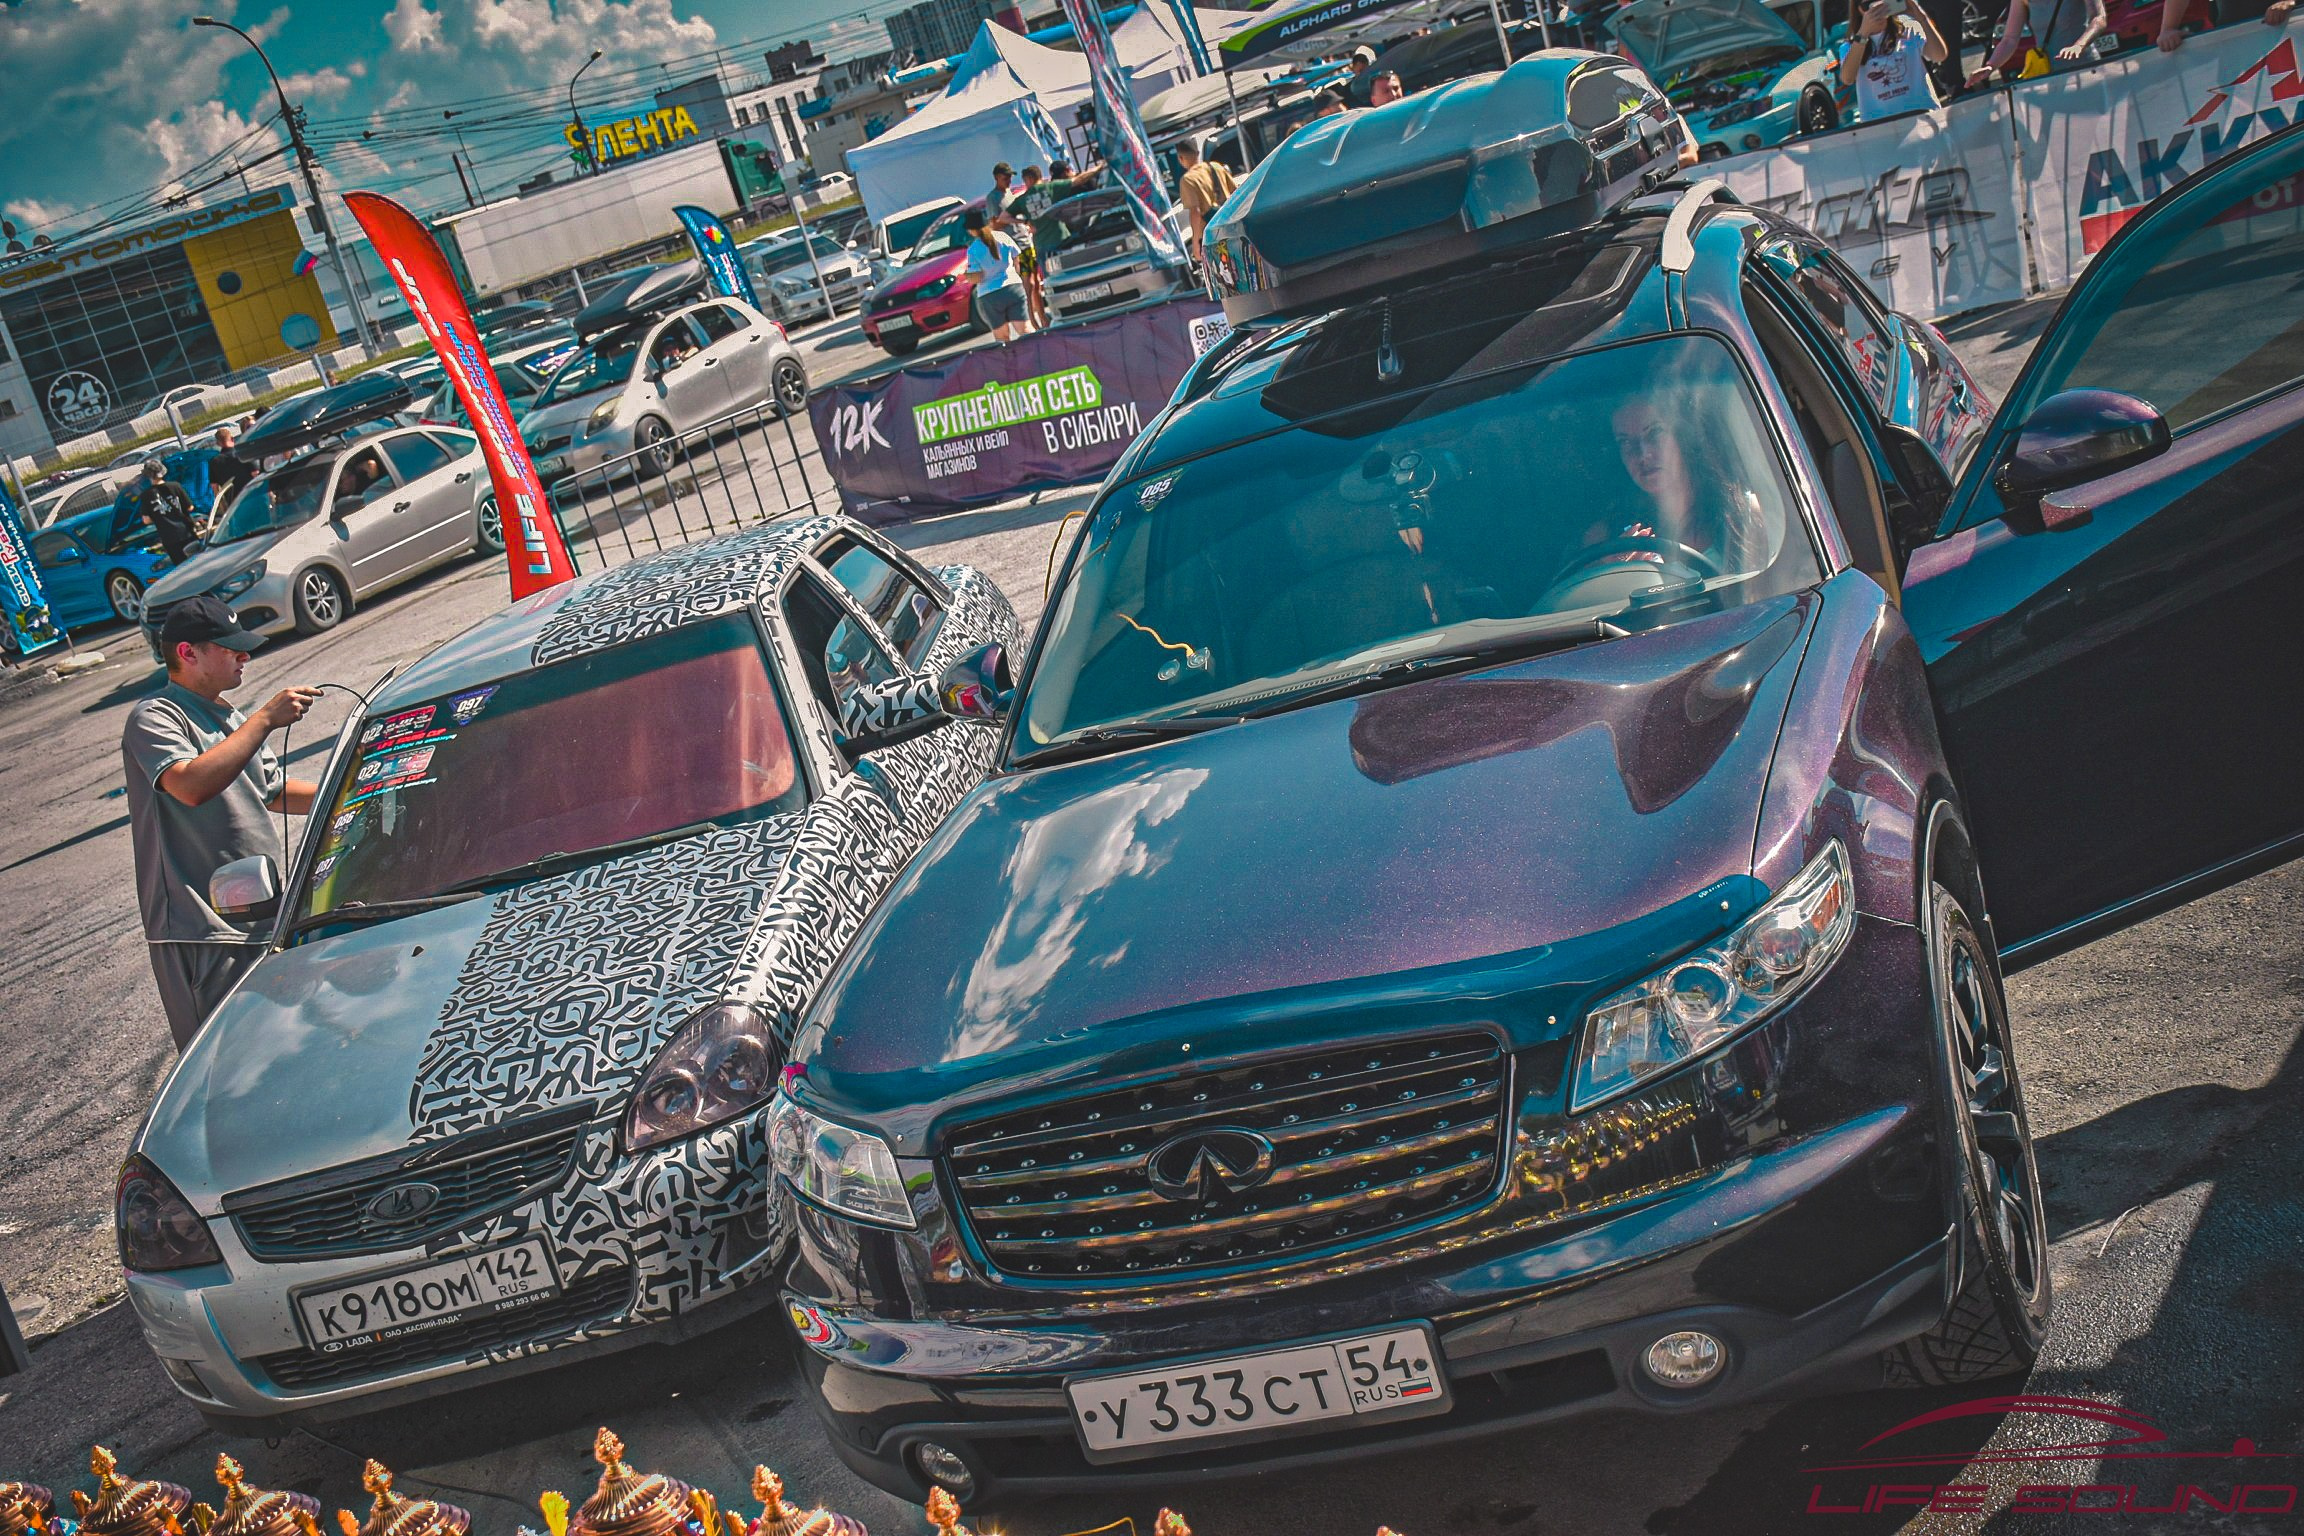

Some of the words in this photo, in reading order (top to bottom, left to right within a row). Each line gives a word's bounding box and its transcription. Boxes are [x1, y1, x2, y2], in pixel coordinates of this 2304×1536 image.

[1280, 3, 1352, 38] ALPHARD
[595, 104, 699, 163] ЛЕНТА
[392, 257, 441, 338] CUP
[55, 380, 101, 412] 24
[915, 384, 1044, 442] КРУПНЕЙШАЯ
[1045, 371, 1098, 413] СЕТЬ
[64, 404, 103, 426] часа
[829, 398, 892, 459] 12K
[1042, 421, 1059, 454] В
[1061, 402, 1143, 450] СИБИРИ
[922, 439, 976, 465] КАЛЬЯННЫХ
[976, 437, 985, 452] И
[926, 456, 978, 479] МАГАЗИНОВ
[1141, 477, 1172, 501] 085
[516, 493, 553, 575] LIFE
[457, 696, 484, 713] 097
[361, 723, 383, 744] 022
[358, 761, 382, 781] 022
[318, 1273, 477, 1337] К918ОМ
[476, 1248, 537, 1286] 142
[497, 1280, 529, 1297] RUS
[516, 1297, 529, 1306] 293
[345, 1335, 373, 1348] LADA
[385, 1330, 402, 1339] ОАО
[1101, 1369, 1329, 1439] У333СТ
[1346, 1340, 1412, 1387] 54
[1354, 1384, 1399, 1406] RUS
